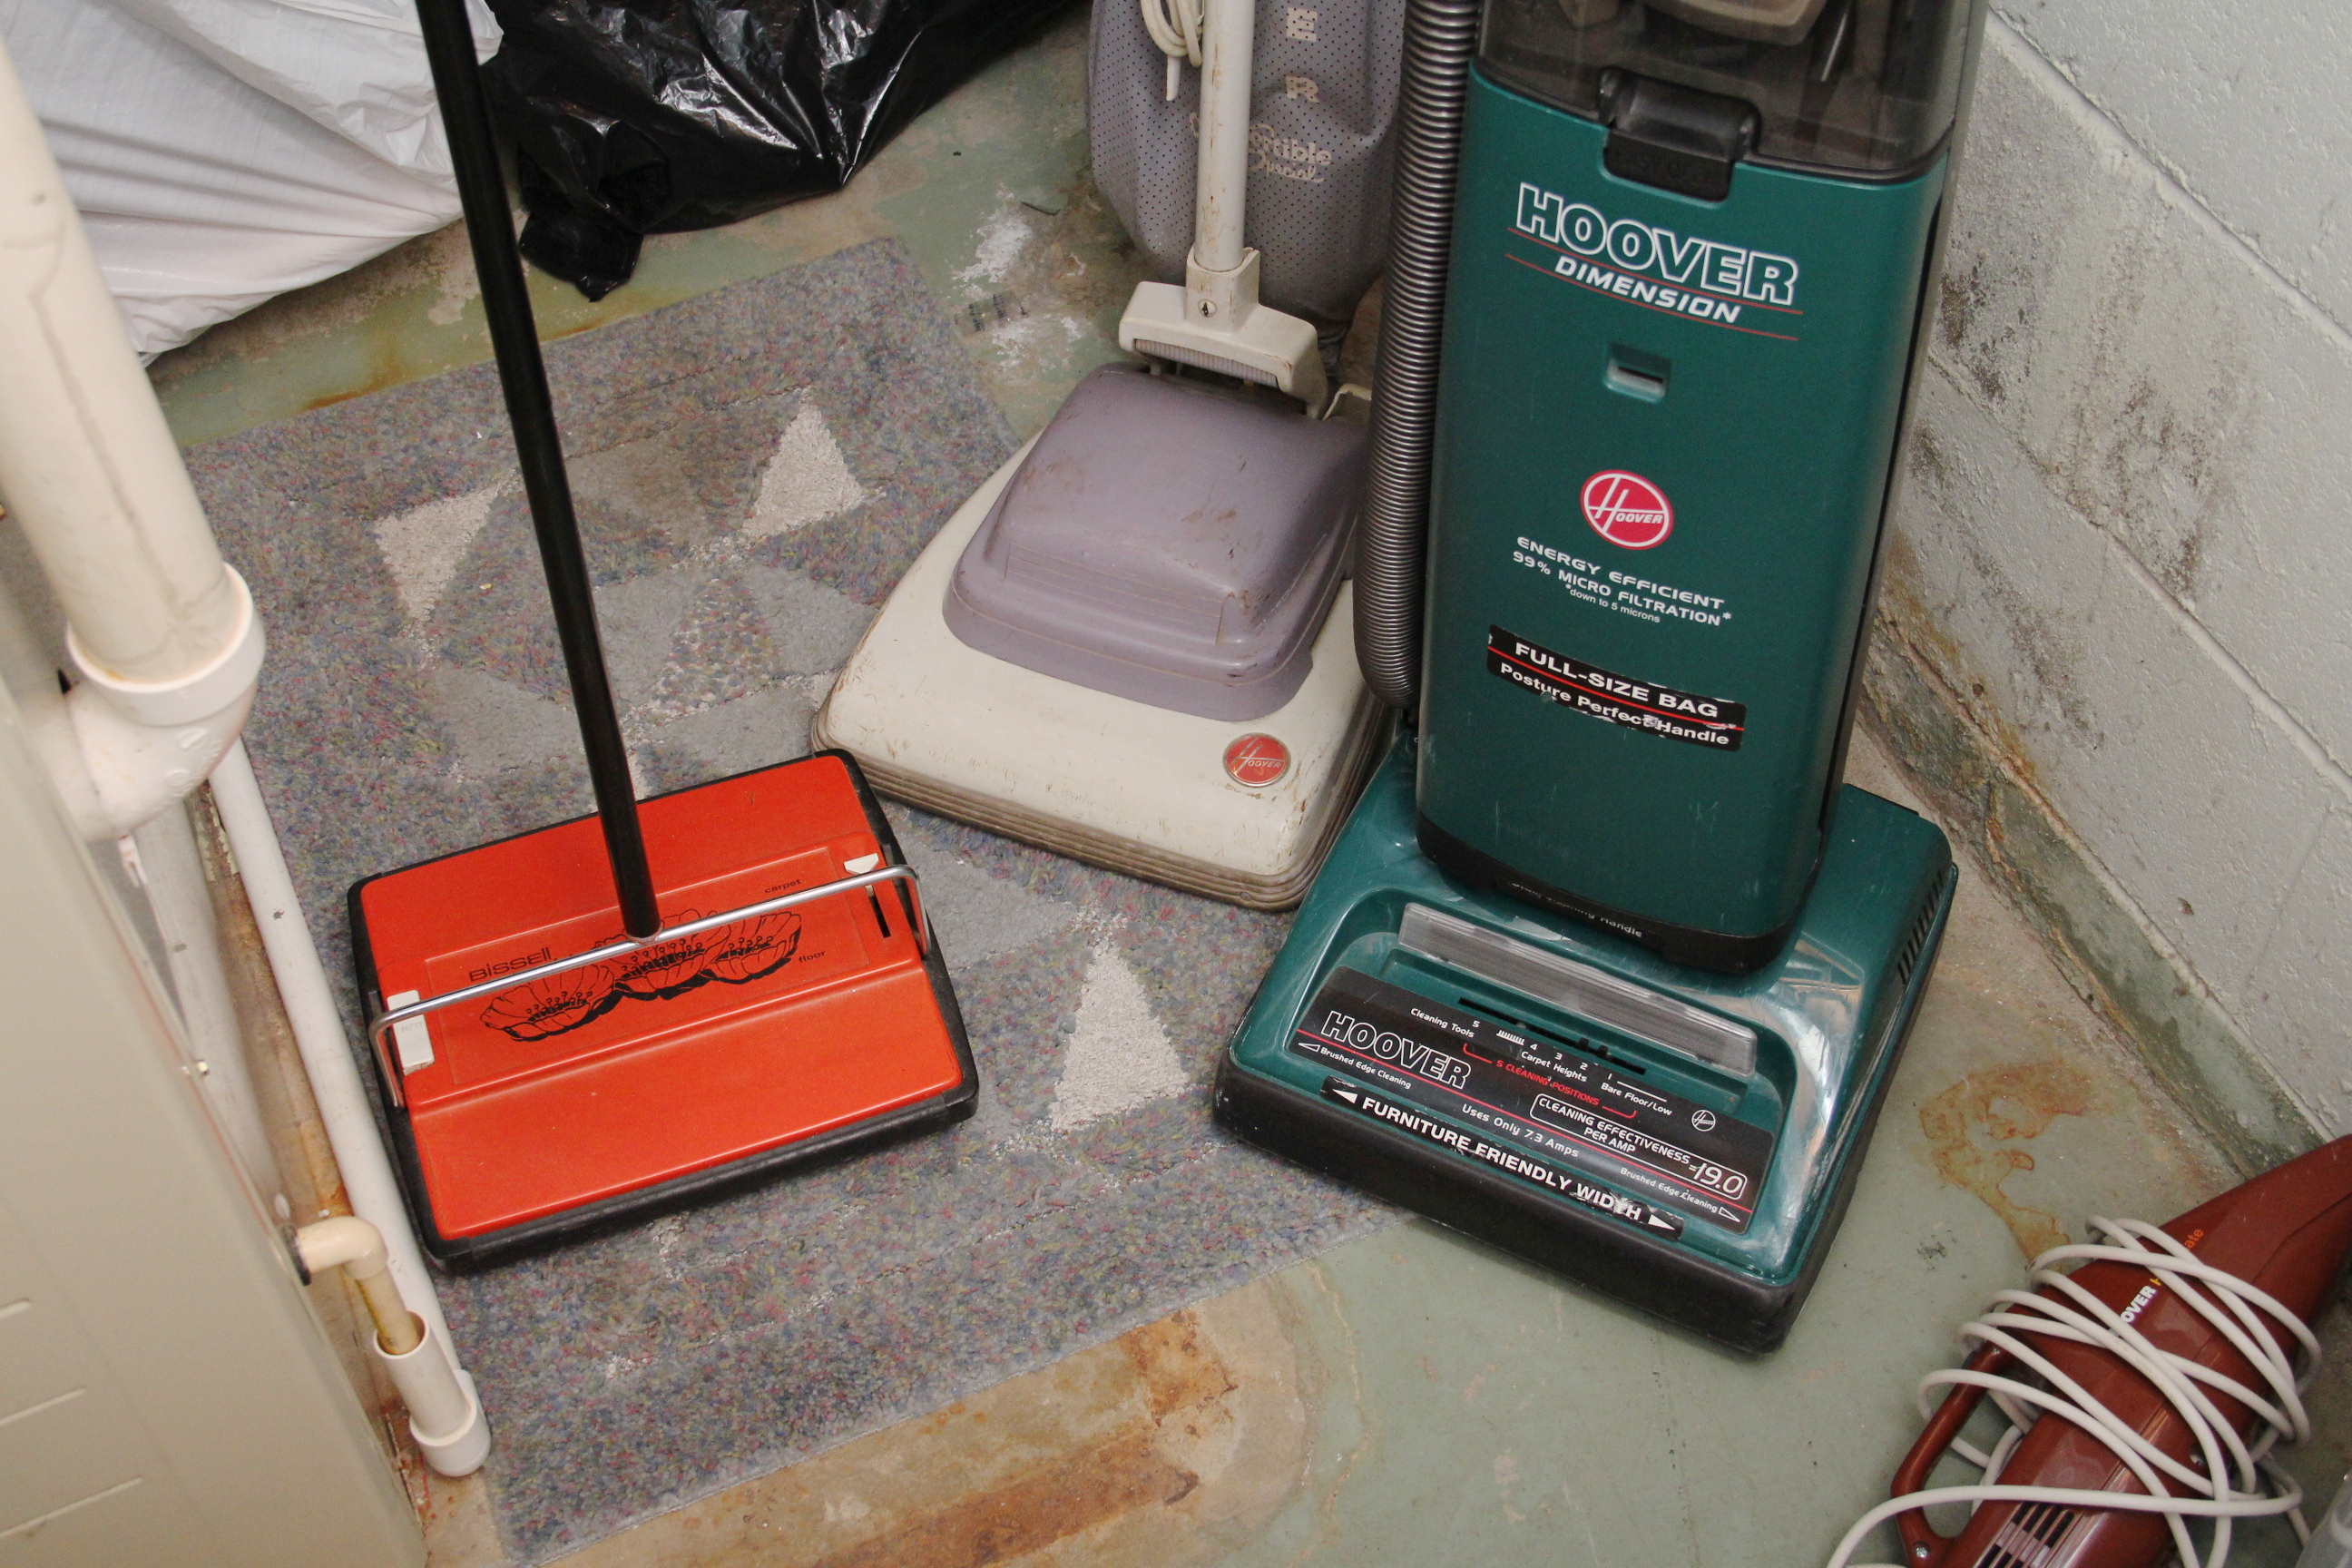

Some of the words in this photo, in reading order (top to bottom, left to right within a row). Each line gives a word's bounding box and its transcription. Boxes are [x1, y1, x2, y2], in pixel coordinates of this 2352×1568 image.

[1516, 182, 1798, 305] HOOVER
[1555, 256, 1741, 323] DIMENSION
[1588, 475, 1666, 533] HOOVER
[1513, 551, 1551, 575] 99%
[1558, 569, 1612, 596] MICRO
[1517, 536, 1601, 575] ENERGY
[1609, 571, 1725, 610] EFFICIENT
[1599, 597, 1609, 608] to
[1611, 603, 1618, 611] 5
[1621, 606, 1661, 623] microns
[1514, 642, 1650, 701] FULL-SIZE
[1658, 692, 1718, 718] BAG
[1501, 662, 1572, 701] Posture
[1654, 719, 1730, 745] Handle
[1227, 736, 1285, 777] HOOVER
[764, 878, 802, 894] carpet
[799, 950, 826, 963] floor
[1410, 1008, 1448, 1029] Cleaning
[1451, 1023, 1475, 1038] Tools
[1472, 1020, 1481, 1028] 5
[1530, 1043, 1538, 1051] 4
[1554, 1052, 1563, 1061] 3
[1580, 1063, 1588, 1071] 2
[1319, 1047, 1355, 1065] Brushed
[1356, 1061, 1377, 1075] Edge
[1377, 1069, 1412, 1090] Cleaning
[1320, 1010, 1472, 1090] HOOVER
[1521, 1051, 1552, 1068] Carpet
[1553, 1063, 1588, 1083] Heights
[1495, 1060, 1504, 1068] 5
[1504, 1063, 1550, 1086] CLEANING
[1552, 1082, 1600, 1106] POSITIONS
[1601, 1082, 1622, 1096] Bare
[1624, 1091, 1673, 1116] Floor/Low
[1362, 1096, 1472, 1151] FURNITURE
[1475, 1142, 1573, 1191] FRIENDLY
[1462, 1103, 1490, 1122] Uses
[1494, 1118, 1521, 1136] Only
[1525, 1129, 1543, 1143] 7.3
[1545, 1138, 1579, 1158] Amps
[1538, 1097, 1594, 1126] CLEANING
[1596, 1122, 1690, 1165] EFFECTIVENESS
[1583, 1126, 1608, 1147] PER
[1608, 1136, 1636, 1153] AMP
[1620, 1167, 1656, 1187] Brushed
[1658, 1182, 1680, 1198] Edge
[1681, 1191, 1719, 1213] Cleaning
